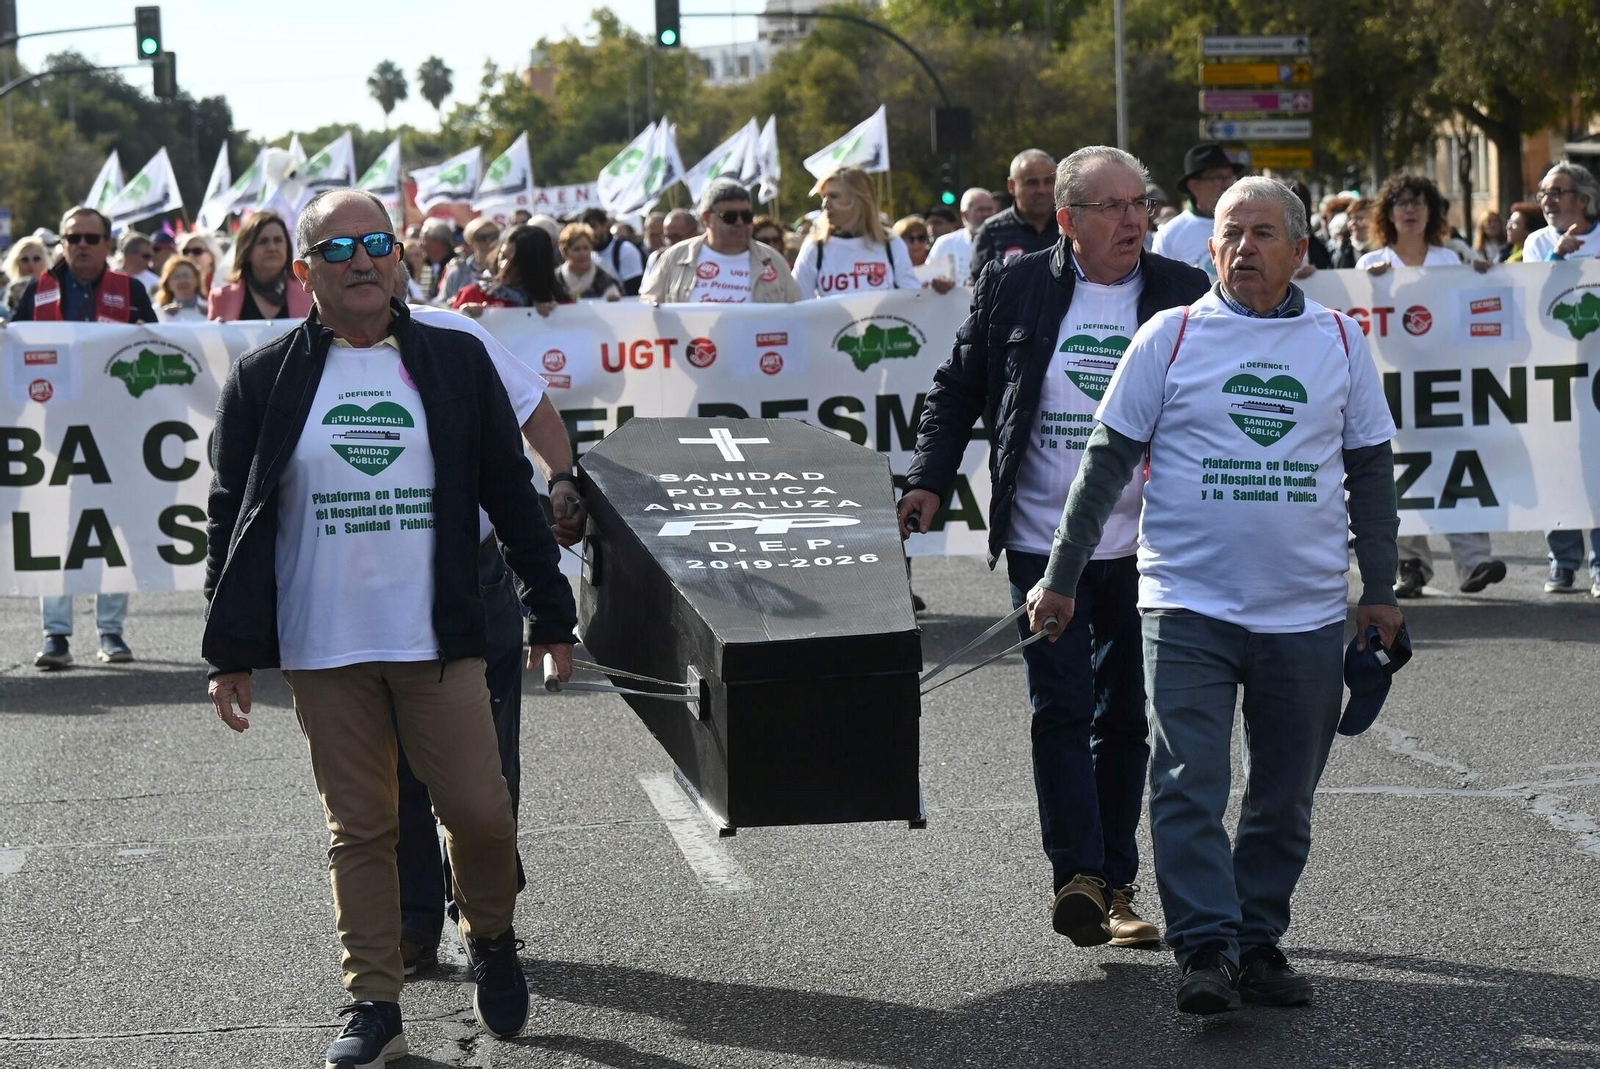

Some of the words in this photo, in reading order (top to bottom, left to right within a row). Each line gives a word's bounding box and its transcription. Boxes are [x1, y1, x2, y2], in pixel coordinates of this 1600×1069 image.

[854, 264, 877, 275] UGT
[821, 273, 862, 293] UGT
[1083, 323, 1119, 331] DEFIENDE
[1336, 307, 1394, 337] GT
[601, 338, 679, 373] UGT
[1246, 362, 1283, 370] DEFIENDE
[1078, 374, 1112, 383] SANIDA
[345, 390, 385, 398] DEFIENDE
[1250, 387, 1299, 399] HOSPITAL!!
[352, 415, 404, 425] HOSPITAL!!
[1041, 411, 1093, 422] Plataforma
[1243, 417, 1283, 429] SANIDAD
[1040, 424, 1053, 435] del
[1055, 425, 1096, 437] Hospita
[1039, 439, 1045, 448] y
[1049, 439, 1058, 449] la
[143, 420, 216, 482] C
[347, 447, 390, 456] SANIDAD
[1202, 458, 1261, 471] Plataforma
[1266, 461, 1279, 471] en
[658, 472, 825, 483] SANIDAD
[1202, 473, 1218, 485] del
[1220, 473, 1266, 487] Hospital
[1268, 476, 1281, 487] de
[312, 490, 371, 505] Plataforma
[375, 490, 390, 500] en
[1201, 490, 1207, 501] y
[1213, 489, 1224, 500] la
[1233, 489, 1278, 501] Sanidad
[1287, 491, 1317, 502] Pública
[331, 505, 376, 519] Hospital
[379, 504, 393, 515] de
[395, 502, 435, 514] Montill
[643, 499, 862, 512] ANDALUZA
[325, 524, 336, 535] la
[344, 520, 391, 534] Sanidad
[12, 508, 127, 571] LA
[708, 541, 747, 553] D.
[758, 540, 797, 552] E.
[806, 539, 845, 550] P.
[685, 553, 879, 570] 2019-2026
